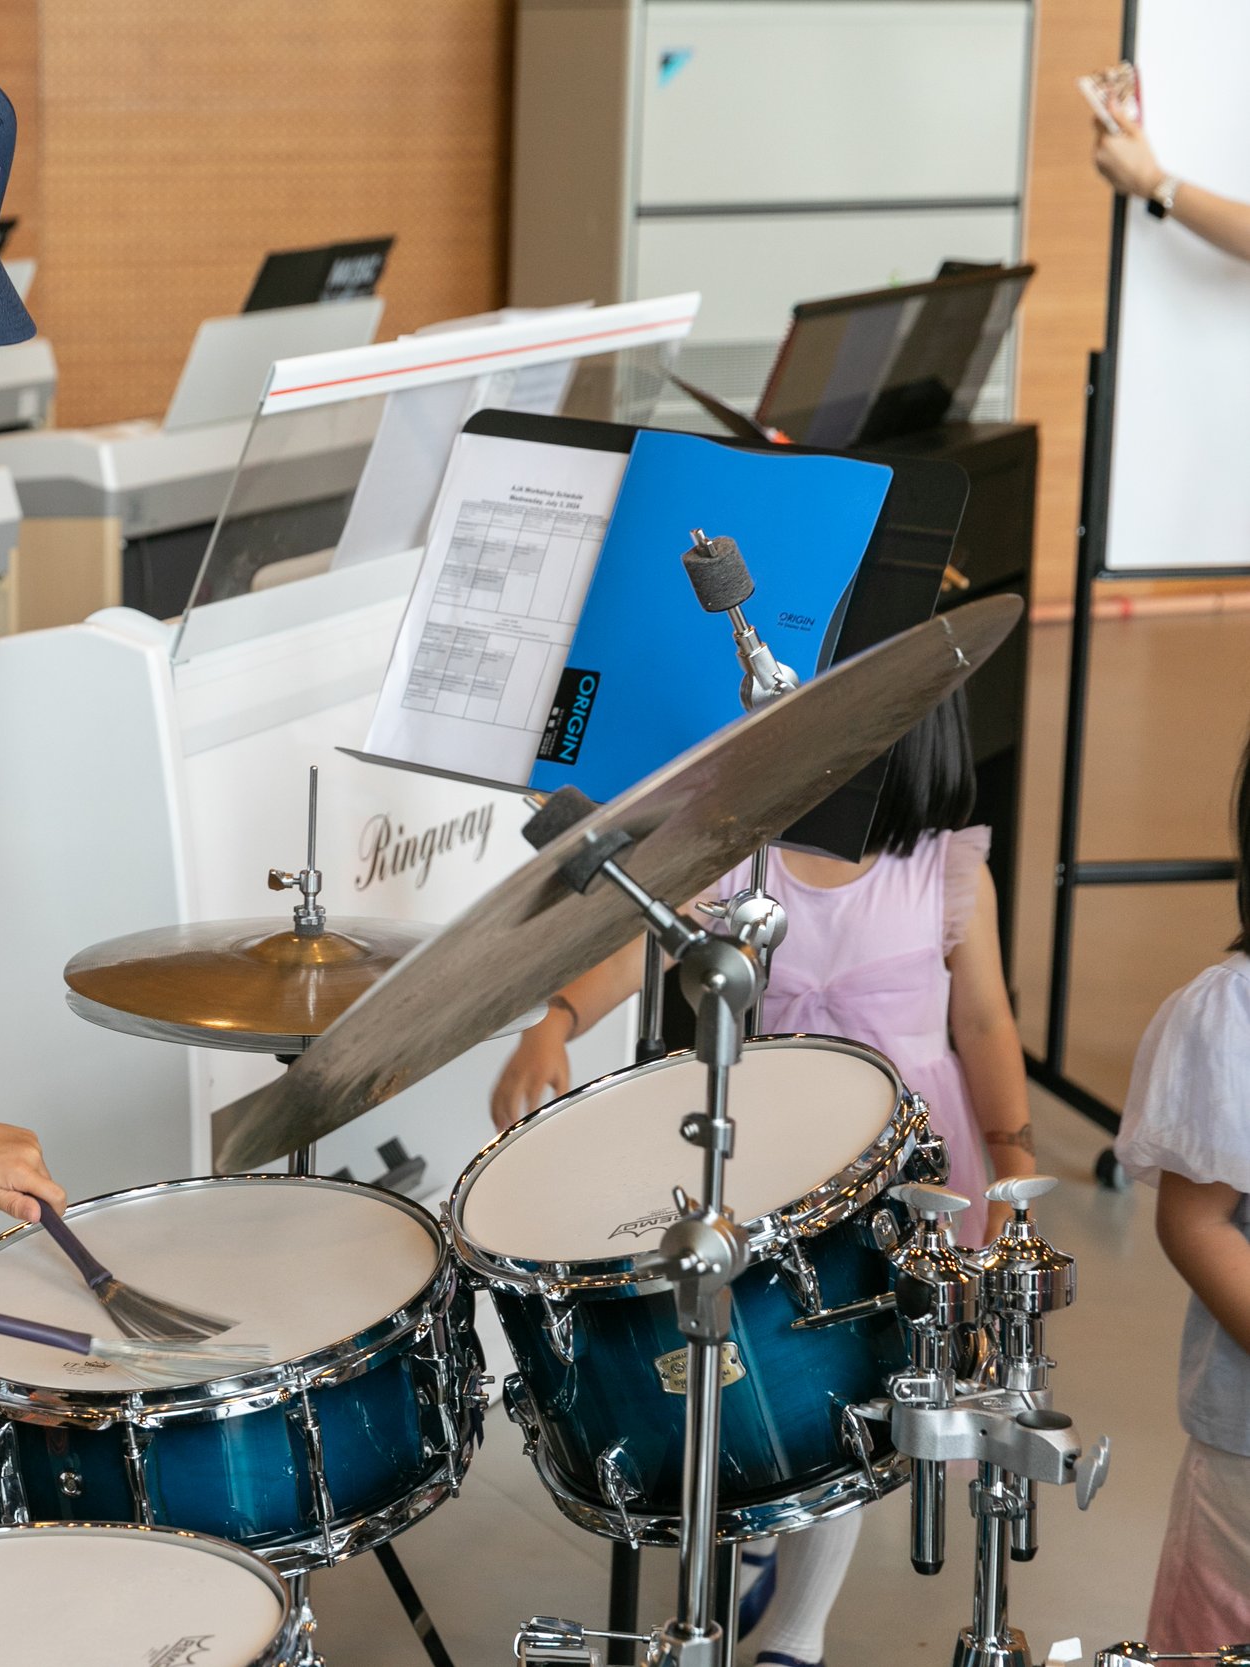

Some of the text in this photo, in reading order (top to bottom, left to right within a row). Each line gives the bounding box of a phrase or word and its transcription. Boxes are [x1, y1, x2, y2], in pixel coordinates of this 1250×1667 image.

[780, 612, 815, 626] ORIGIN
[558, 676, 595, 760] ORIGIN
[354, 802, 494, 891] Ringway
